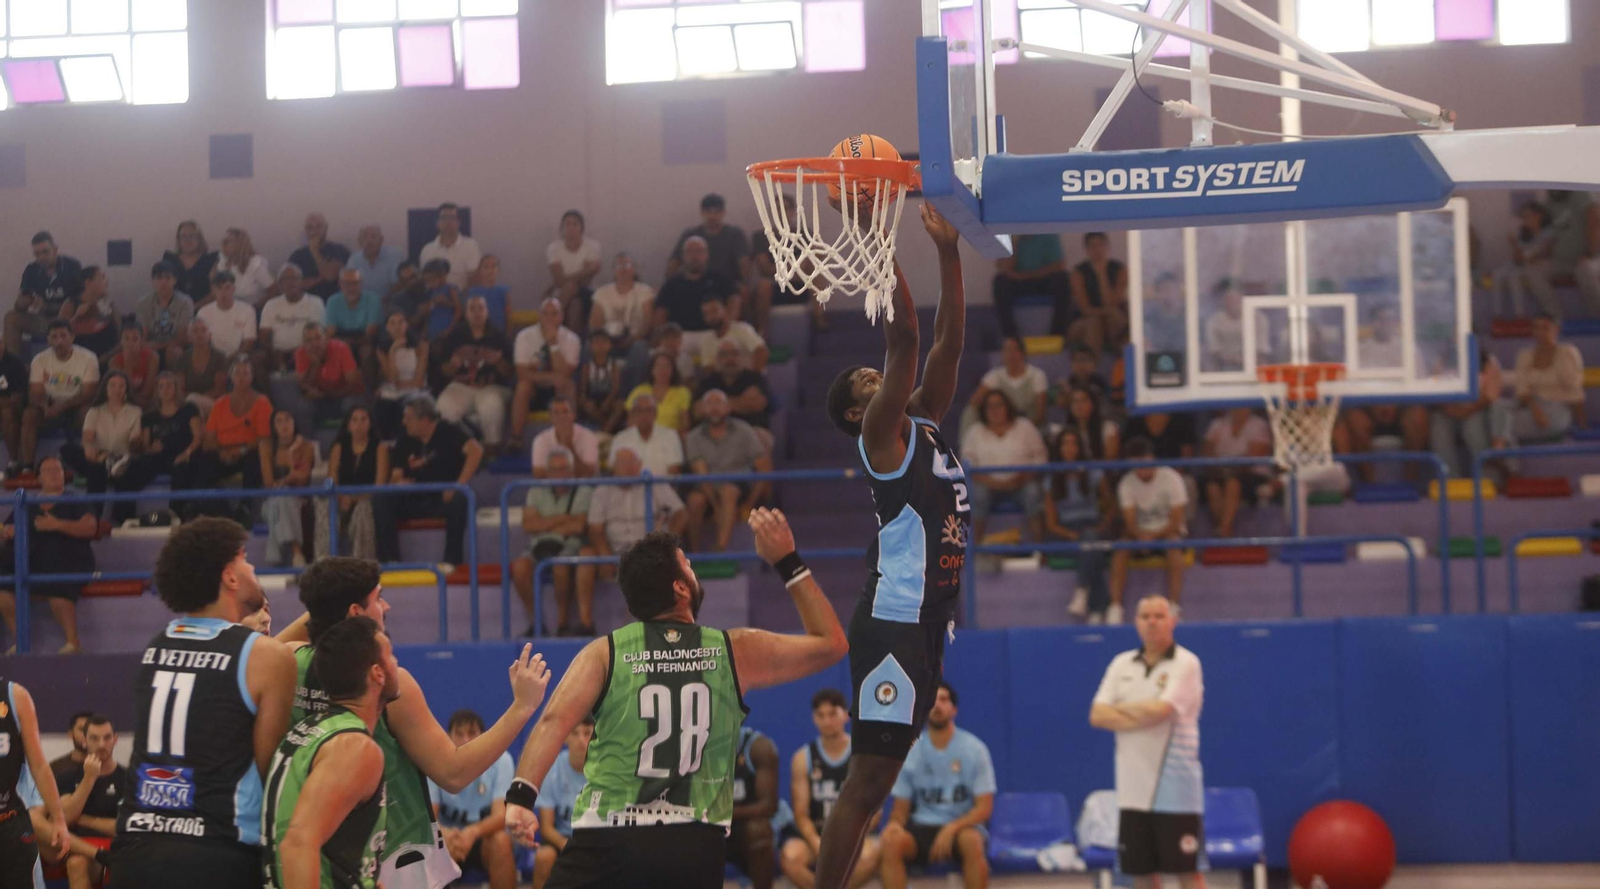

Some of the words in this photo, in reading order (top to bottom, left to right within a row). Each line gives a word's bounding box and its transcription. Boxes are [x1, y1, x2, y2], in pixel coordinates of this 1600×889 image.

[1062, 167, 1170, 193] SPORT
[1172, 159, 1306, 196] SYSTEM
[142, 648, 157, 664] EL
[623, 649, 651, 663] CLUB
[632, 662, 654, 674] SAN
[657, 659, 717, 673] FERNANDO
[147, 670, 197, 757] 11
[638, 683, 709, 777] 28
